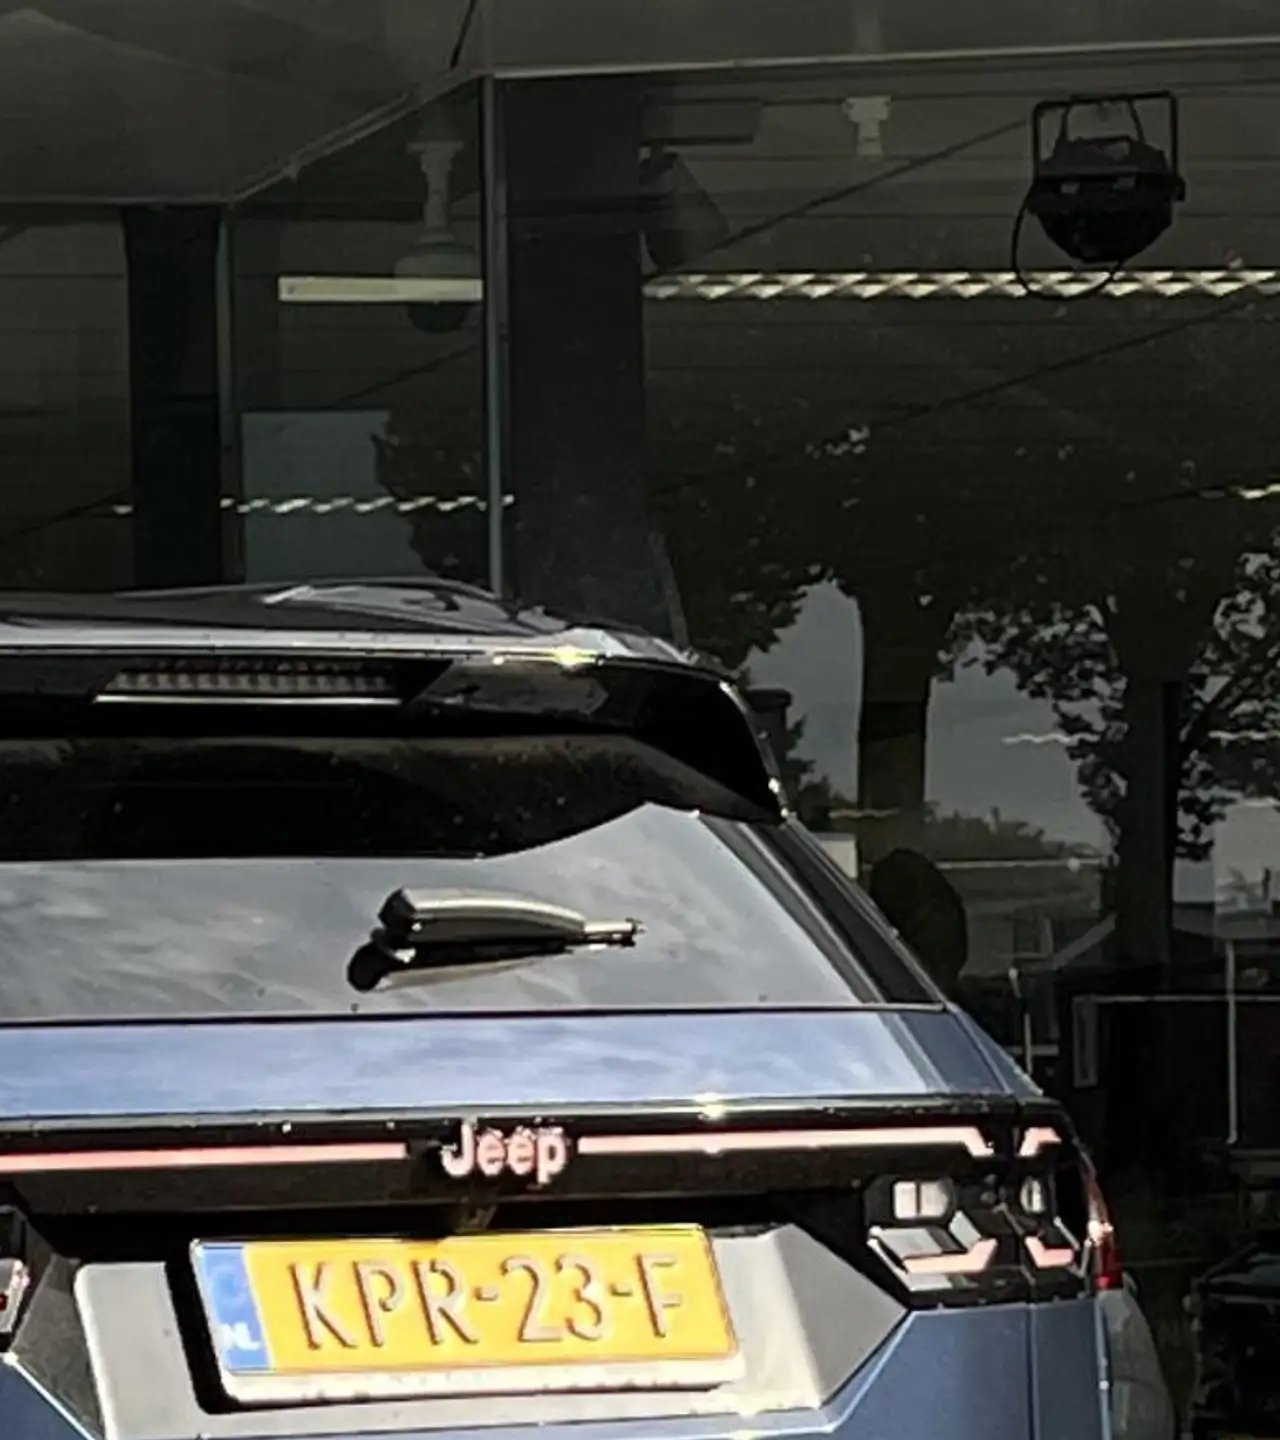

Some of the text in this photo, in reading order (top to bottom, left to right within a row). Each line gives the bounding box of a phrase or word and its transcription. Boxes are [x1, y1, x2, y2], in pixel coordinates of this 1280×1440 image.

[440, 1116, 567, 1185] Jeep
[288, 1251, 683, 1350] KPR-23-F
[219, 1320, 261, 1351] NL
